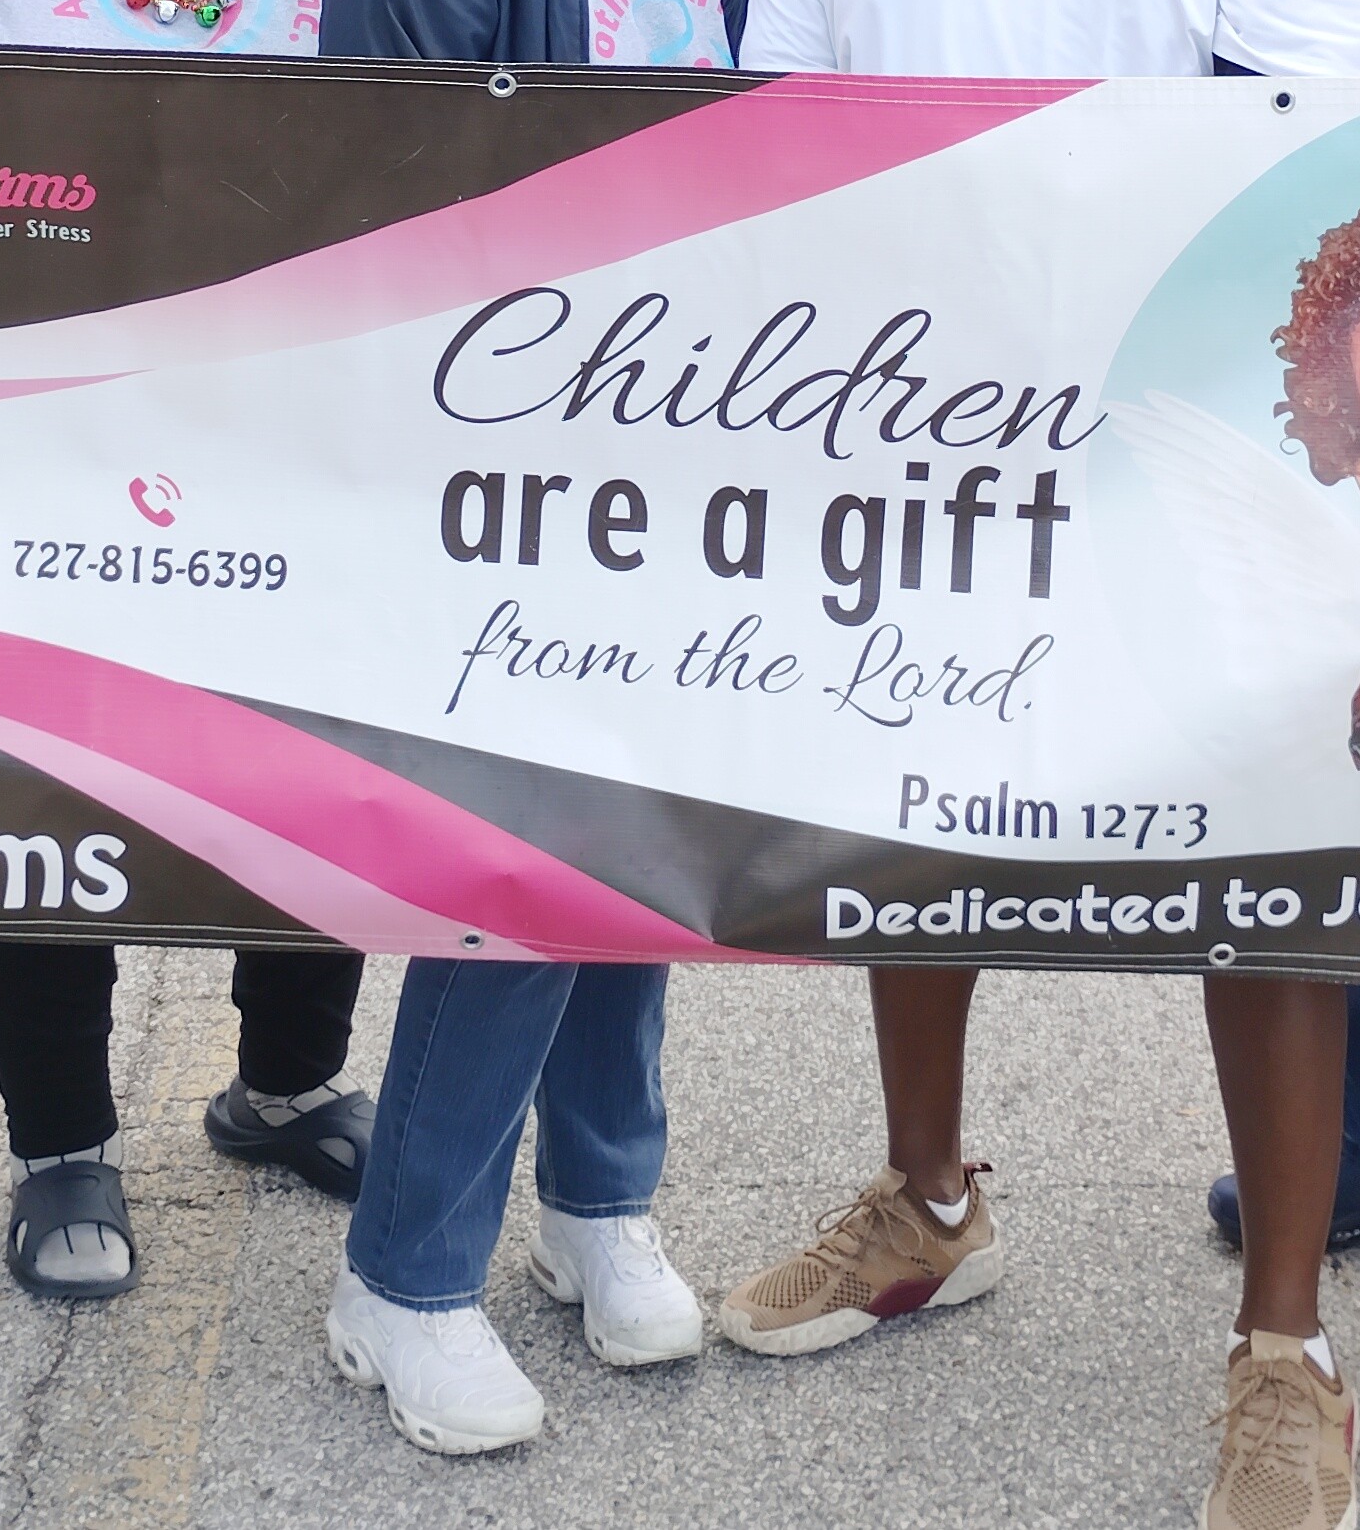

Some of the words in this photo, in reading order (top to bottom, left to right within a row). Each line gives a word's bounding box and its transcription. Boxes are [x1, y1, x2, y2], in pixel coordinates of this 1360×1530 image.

[25, 217, 92, 244] Stress
[432, 285, 1109, 460] Children
[12, 539, 289, 592] 727-815-6399
[439, 468, 649, 572] are
[702, 485, 769, 580] a
[820, 461, 1071, 627] gift
[444, 599, 654, 716] from
[673, 613, 804, 695] the
[822, 622, 1055, 728] Lord.
[897, 772, 1062, 842] Psalm
[1078, 798, 1210, 850] 127:3
[824, 881, 1202, 940] Dedicated
[1222, 876, 1303, 931] to
